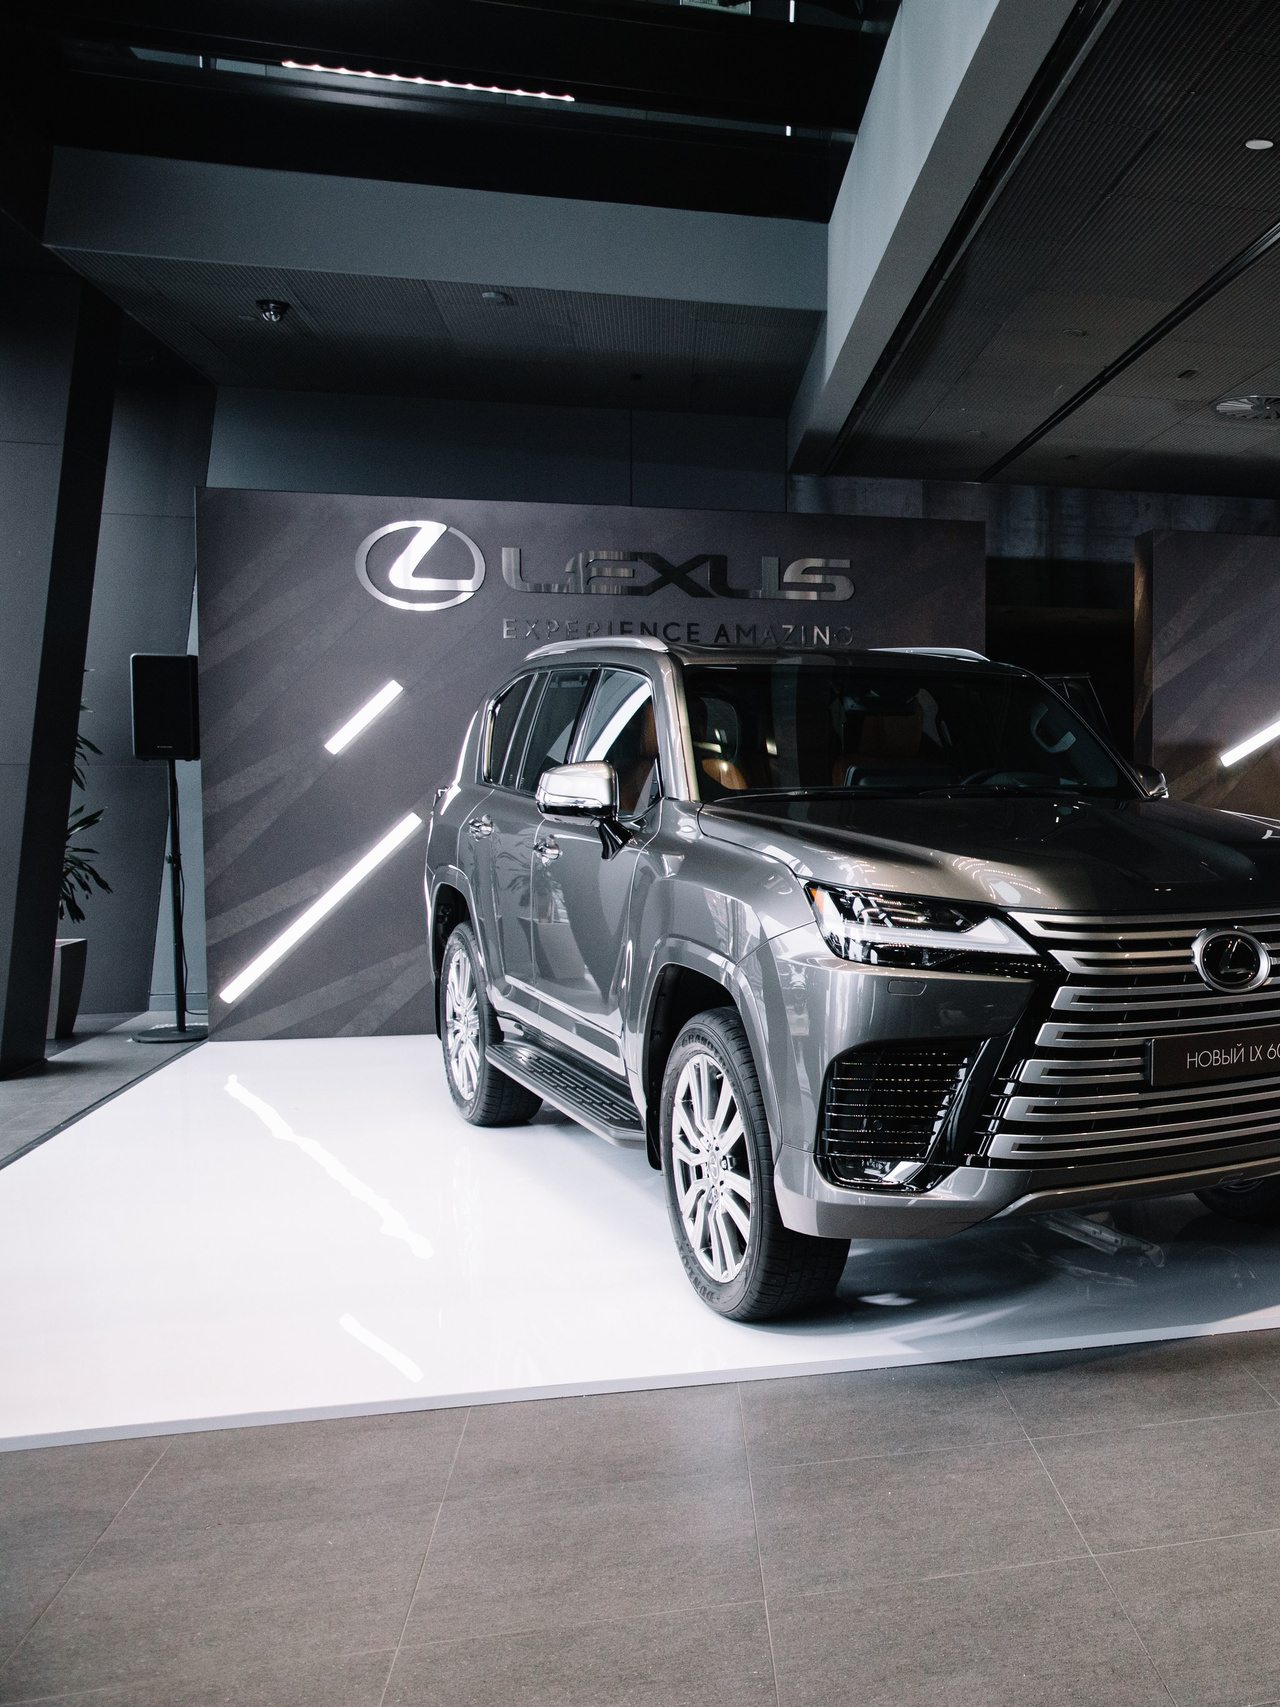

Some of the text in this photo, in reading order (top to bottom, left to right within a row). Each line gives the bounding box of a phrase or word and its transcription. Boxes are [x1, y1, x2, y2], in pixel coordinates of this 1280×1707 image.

[502, 547, 856, 600] LEXUS
[502, 618, 853, 646] EXPERIENCE AMAZING
[1186, 1043, 1245, 1069] НОВЫЙ
[1249, 1045, 1263, 1062] LX
